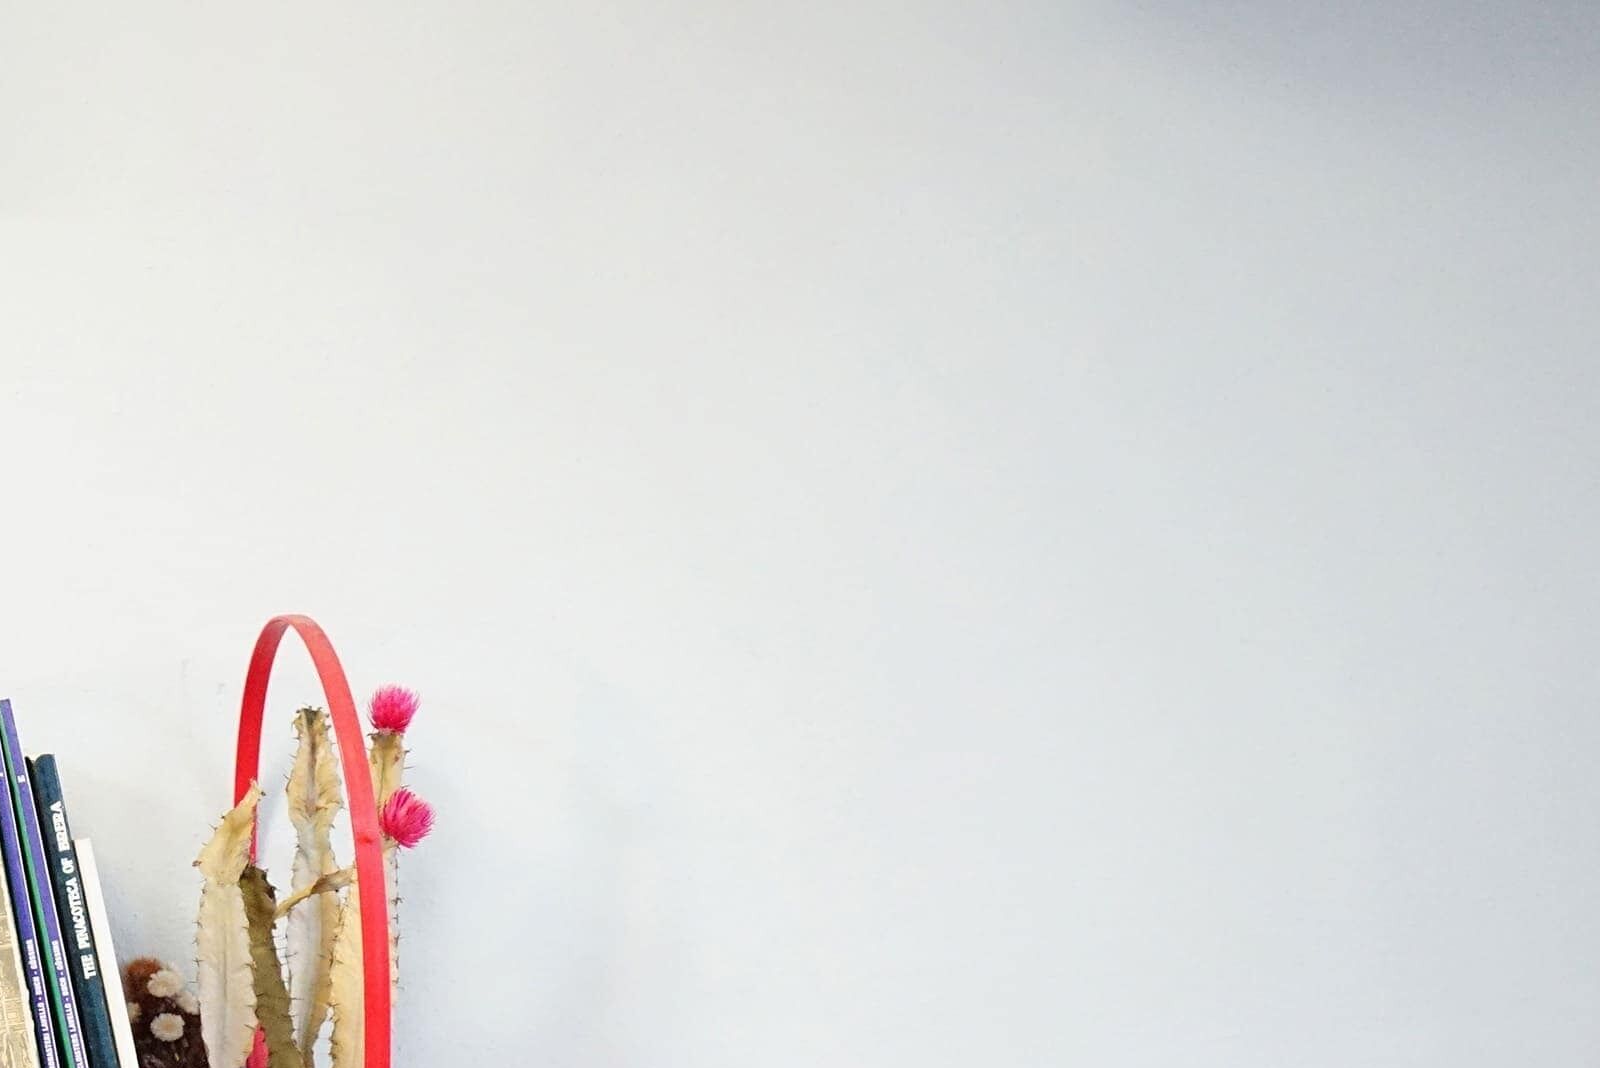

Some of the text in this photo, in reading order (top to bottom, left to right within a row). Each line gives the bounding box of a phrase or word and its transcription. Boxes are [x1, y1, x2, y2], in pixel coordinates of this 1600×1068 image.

[49, 800, 97, 980] THE PINACOTECA OF BRERA
[36, 1002, 50, 1032] LAVELLO
[64, 1003, 78, 1033] LAVELLO
